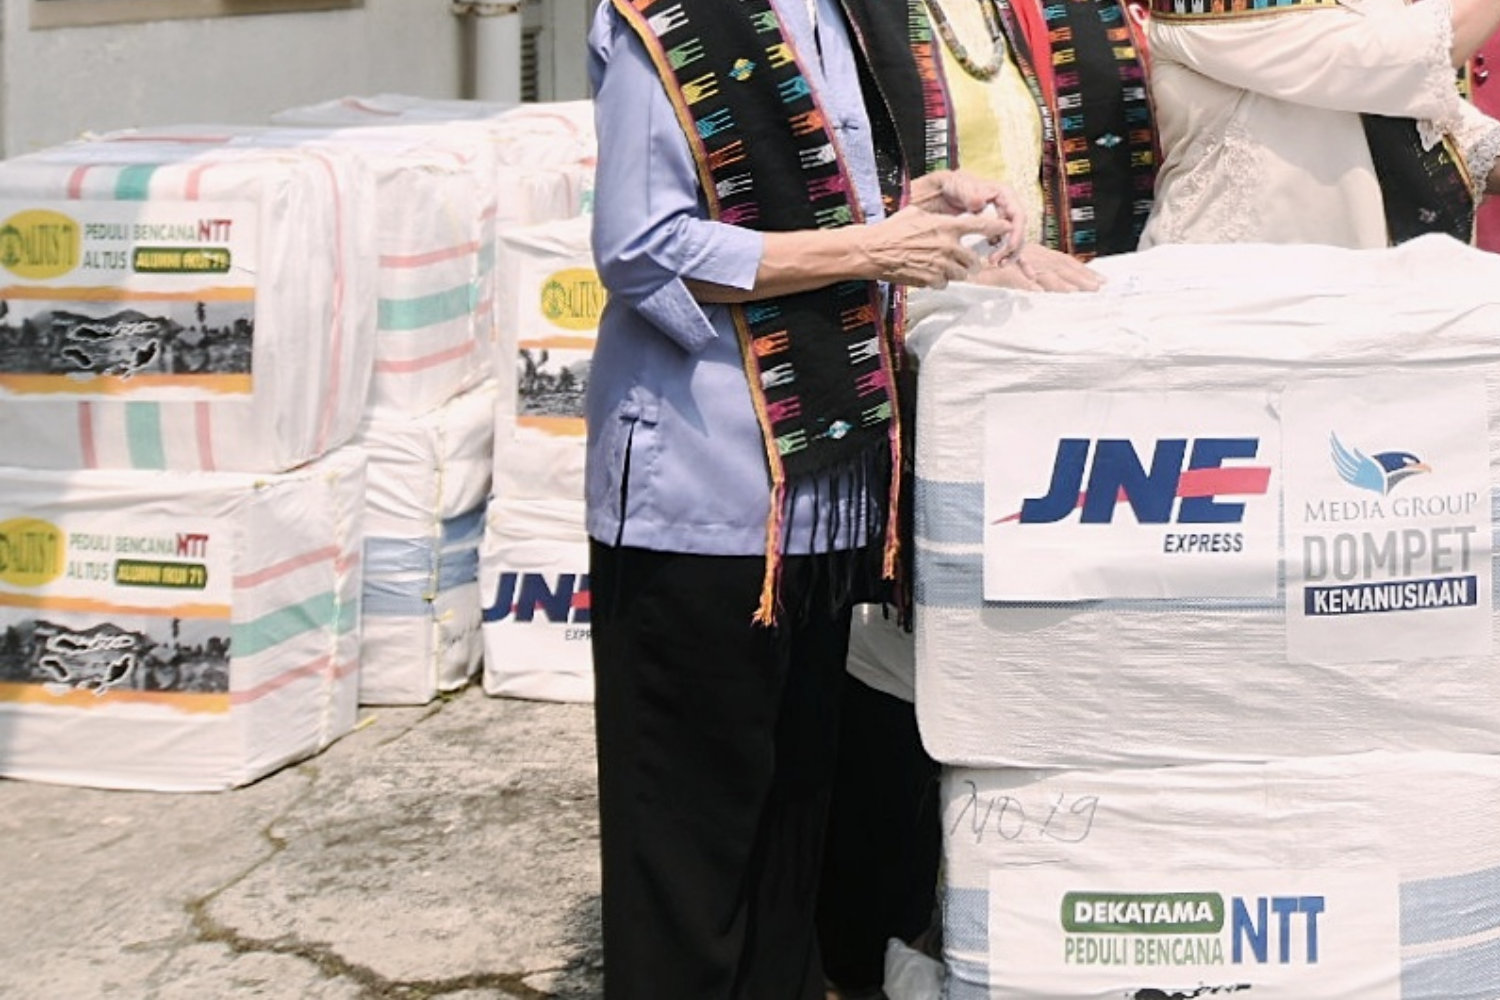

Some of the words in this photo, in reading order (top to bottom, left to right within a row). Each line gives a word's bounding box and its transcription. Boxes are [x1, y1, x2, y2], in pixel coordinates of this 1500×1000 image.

[84, 223, 128, 240] PEDULI
[133, 223, 196, 241] BENCANA
[198, 219, 232, 242] NTT
[83, 250, 128, 270] ALTUS
[1019, 438, 1271, 524] JNE
[1304, 499, 1385, 523] MEDIA
[1392, 492, 1477, 518] GROUP
[70, 532, 111, 551] PEDULI
[115, 534, 175, 555] BENCANA
[176, 532, 209, 558] NTT
[1164, 532, 1244, 553] EXPRESS
[1303, 526, 1477, 582] DOMPET
[67, 562, 110, 582] ALTUS
[1314, 579, 1468, 613] KEMANUSIAAN
[565, 628, 592, 641] EXPR
[1073, 900, 1215, 925] DEKATAMA
[1231, 895, 1325, 964] NTT
[1064, 936, 1128, 966] PEDULI
[1134, 936, 1225, 966] BENCANA
